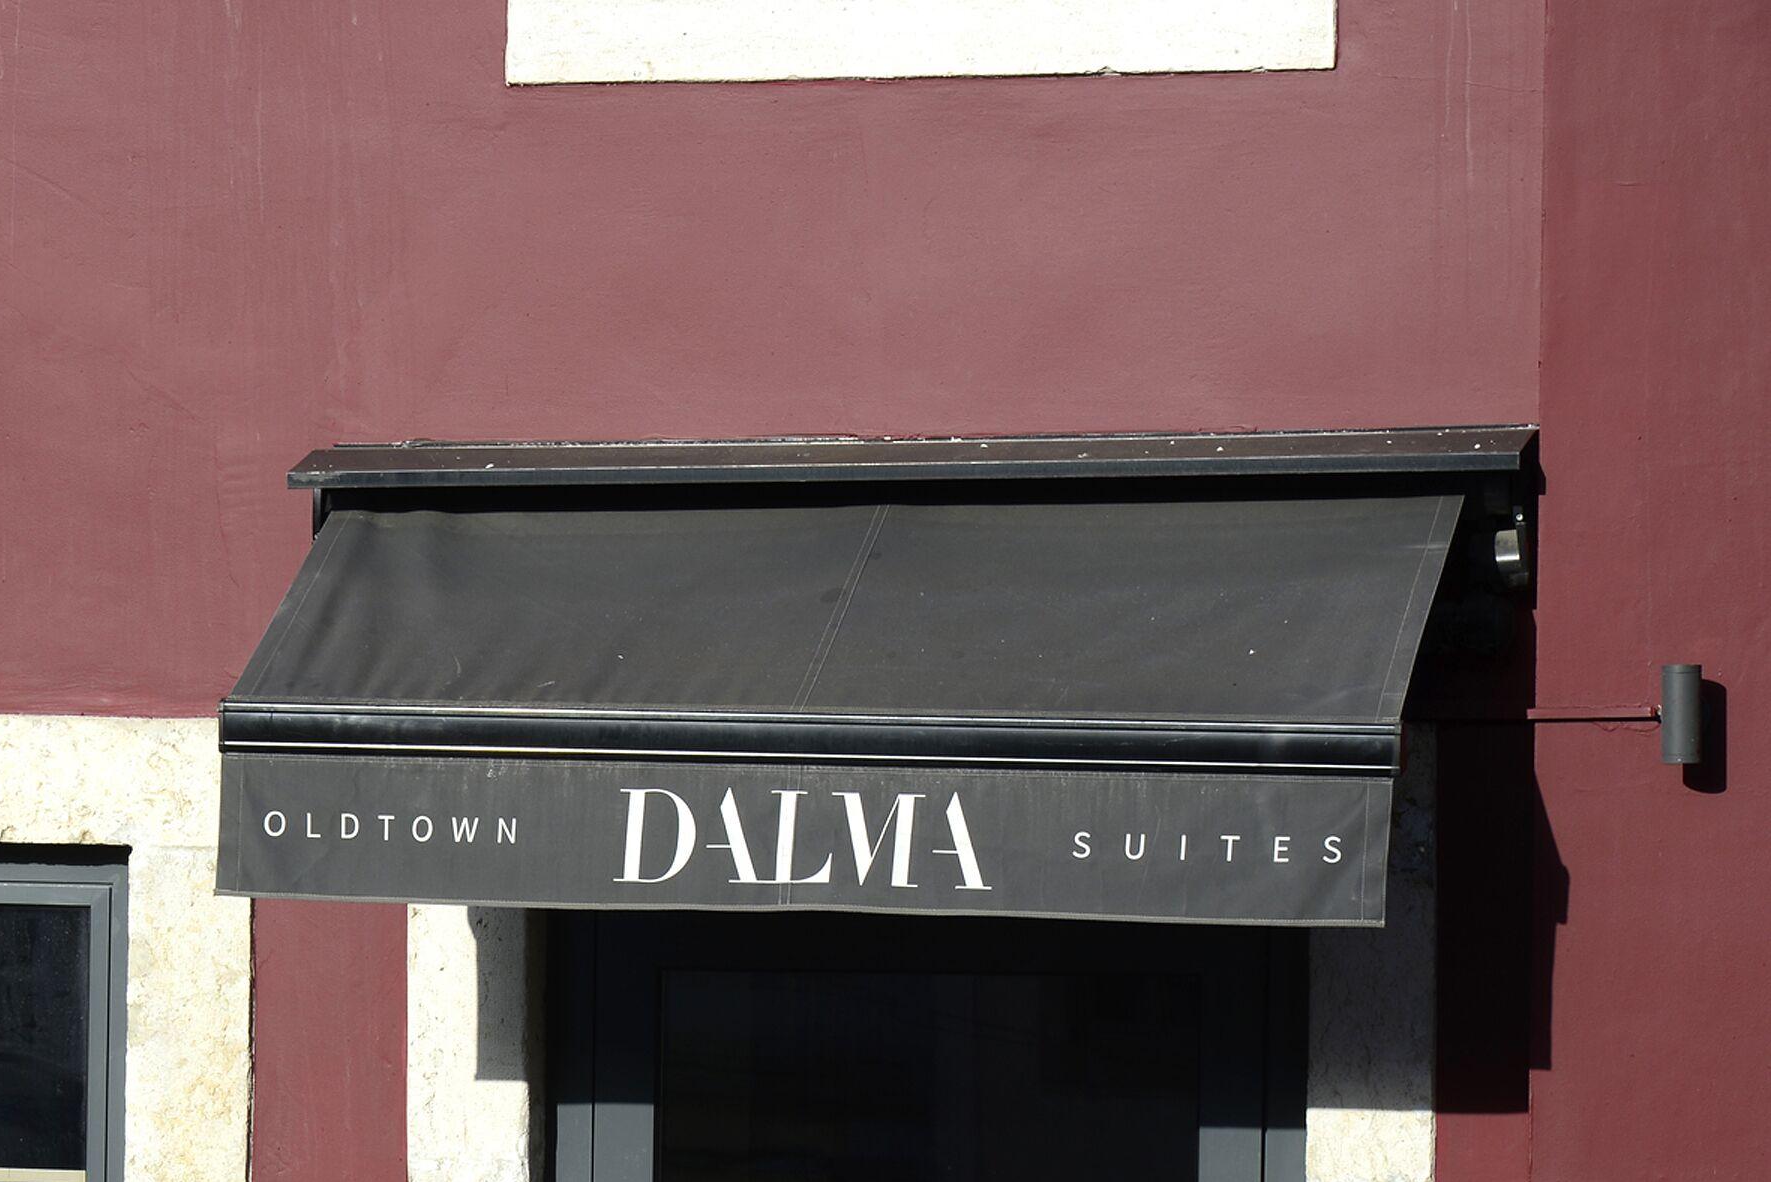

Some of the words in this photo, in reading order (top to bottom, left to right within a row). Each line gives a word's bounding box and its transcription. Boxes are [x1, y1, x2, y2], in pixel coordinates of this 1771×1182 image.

[263, 810, 518, 844] OLDTOWN
[612, 787, 992, 890] DALMA
[1071, 831, 1344, 864] SUITES
